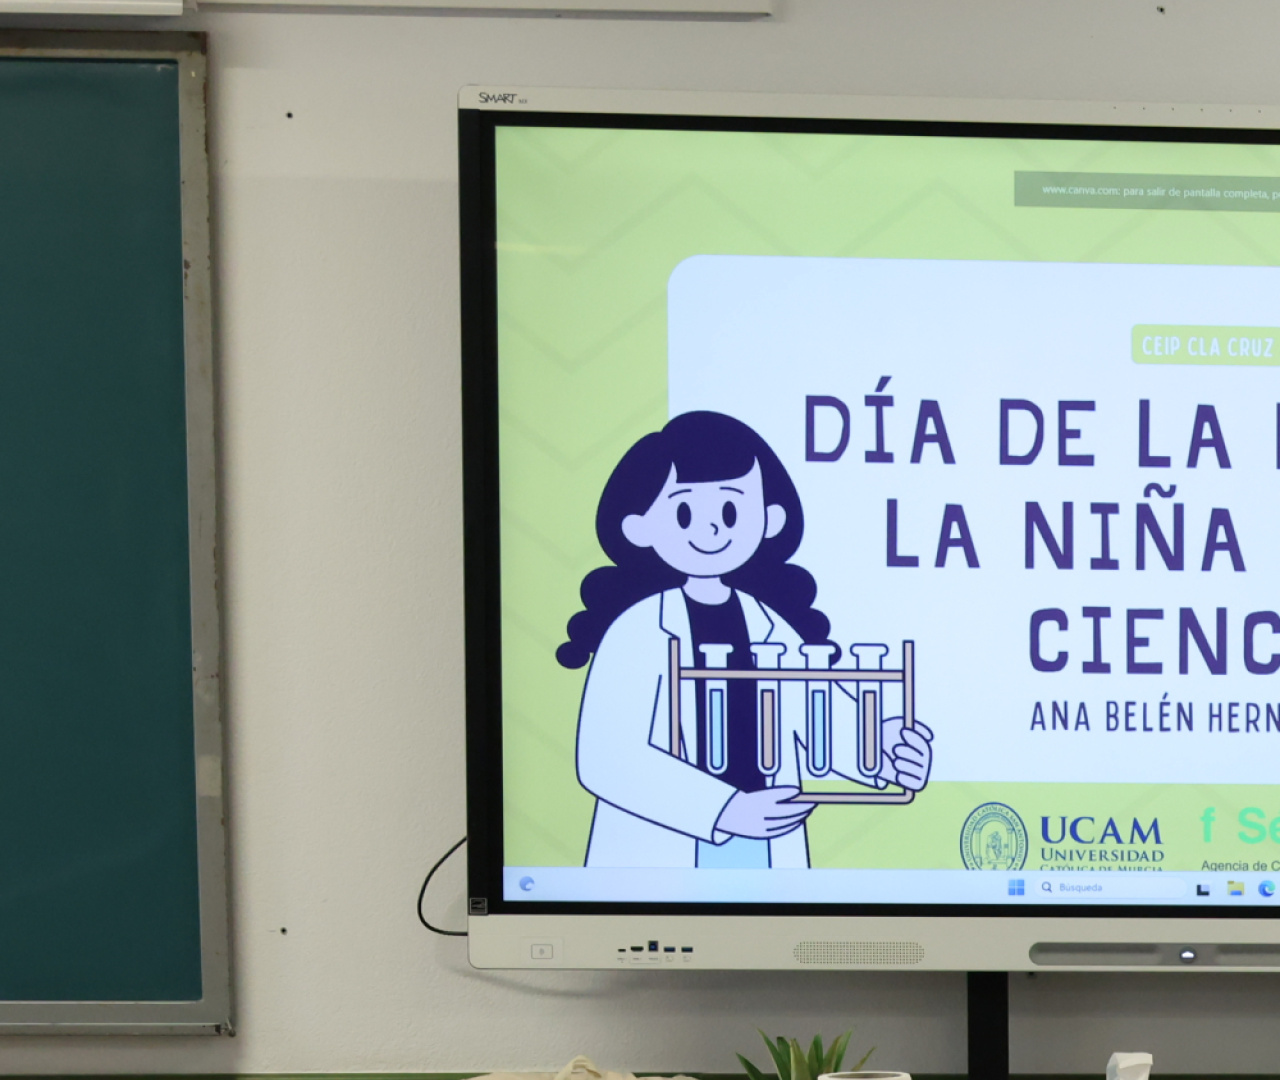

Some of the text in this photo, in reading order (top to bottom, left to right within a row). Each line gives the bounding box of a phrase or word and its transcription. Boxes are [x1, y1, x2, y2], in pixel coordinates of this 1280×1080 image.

[479, 92, 518, 104] SMART
[1123, 187, 1144, 198] para
[1147, 186, 1166, 197] salir
[1168, 187, 1181, 197] de
[1183, 188, 1221, 199] pantalla
[1223, 189, 1270, 200] completa,
[1142, 336, 1275, 358] CEIP CLA CRUZ
[804, 375, 957, 464] DÍA
[999, 399, 1096, 467] DE
[1137, 399, 1232, 470] LA
[886, 498, 980, 568] LA
[1024, 482, 1246, 572] NIÑA
[1030, 701, 1091, 732] ANA
[1106, 692, 1195, 733] BELÉN
[1040, 816, 1165, 845] UCAM
[1200, 807, 1216, 843] f
[1201, 860, 1249, 872] Agencia
[1253, 860, 1268, 872] de
[1059, 882, 1103, 894] Búsqueda
